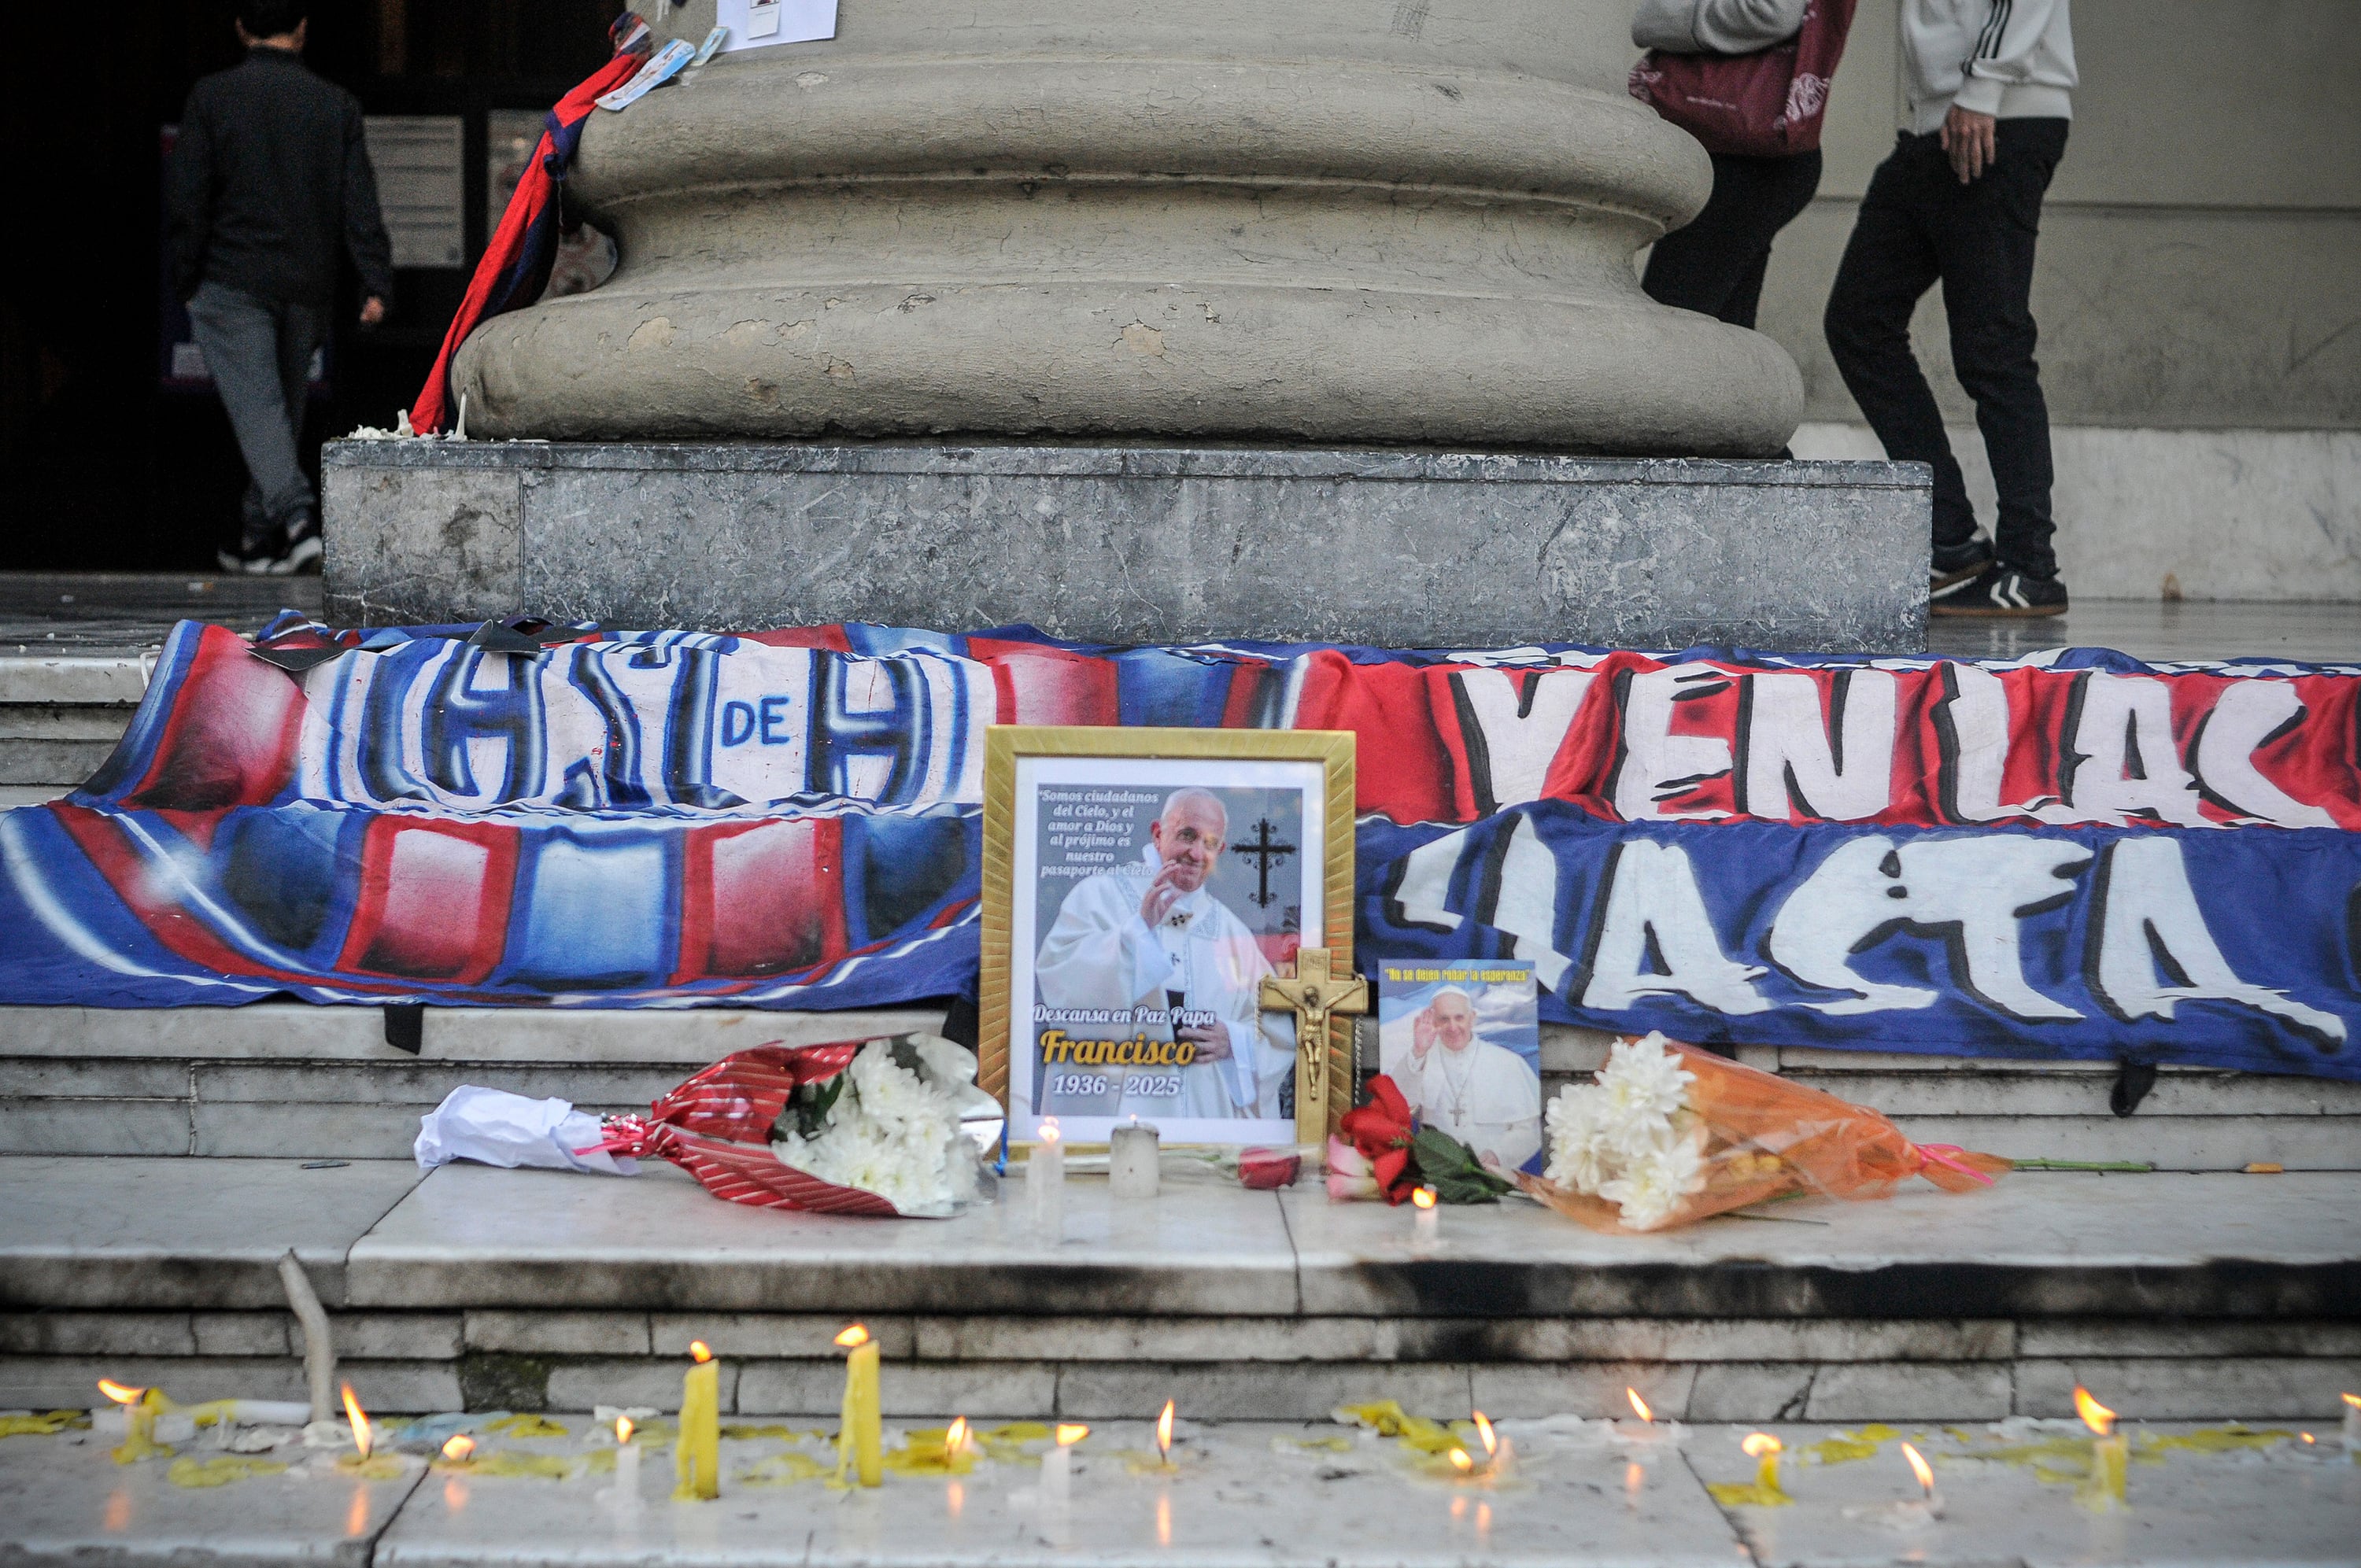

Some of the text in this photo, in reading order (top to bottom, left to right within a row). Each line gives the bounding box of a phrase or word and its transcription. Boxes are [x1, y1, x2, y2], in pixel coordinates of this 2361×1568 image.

[722, 696, 790, 748] DE
[1084, 790, 1159, 803] ciudadanos
[1053, 804, 1135, 821] del Cielo, y el
[1047, 820, 1135, 836] amor a Dios y
[1050, 833, 1132, 850] al prójimo es
[1066, 851, 1114, 863] nuestro
[1040, 865, 1103, 879] pasaporte
[1107, 864, 1120, 875] al
[1402, 969, 1413, 981] se
[1416, 968, 1440, 982] dejen
[1469, 968, 1478, 981] la
[1033, 1004, 1216, 1029] Descansa en Paz Papa
[1040, 1030, 1196, 1065] Francisco
[1052, 1075, 1107, 1095] 1936
[1125, 1075, 1180, 1095] 2025
